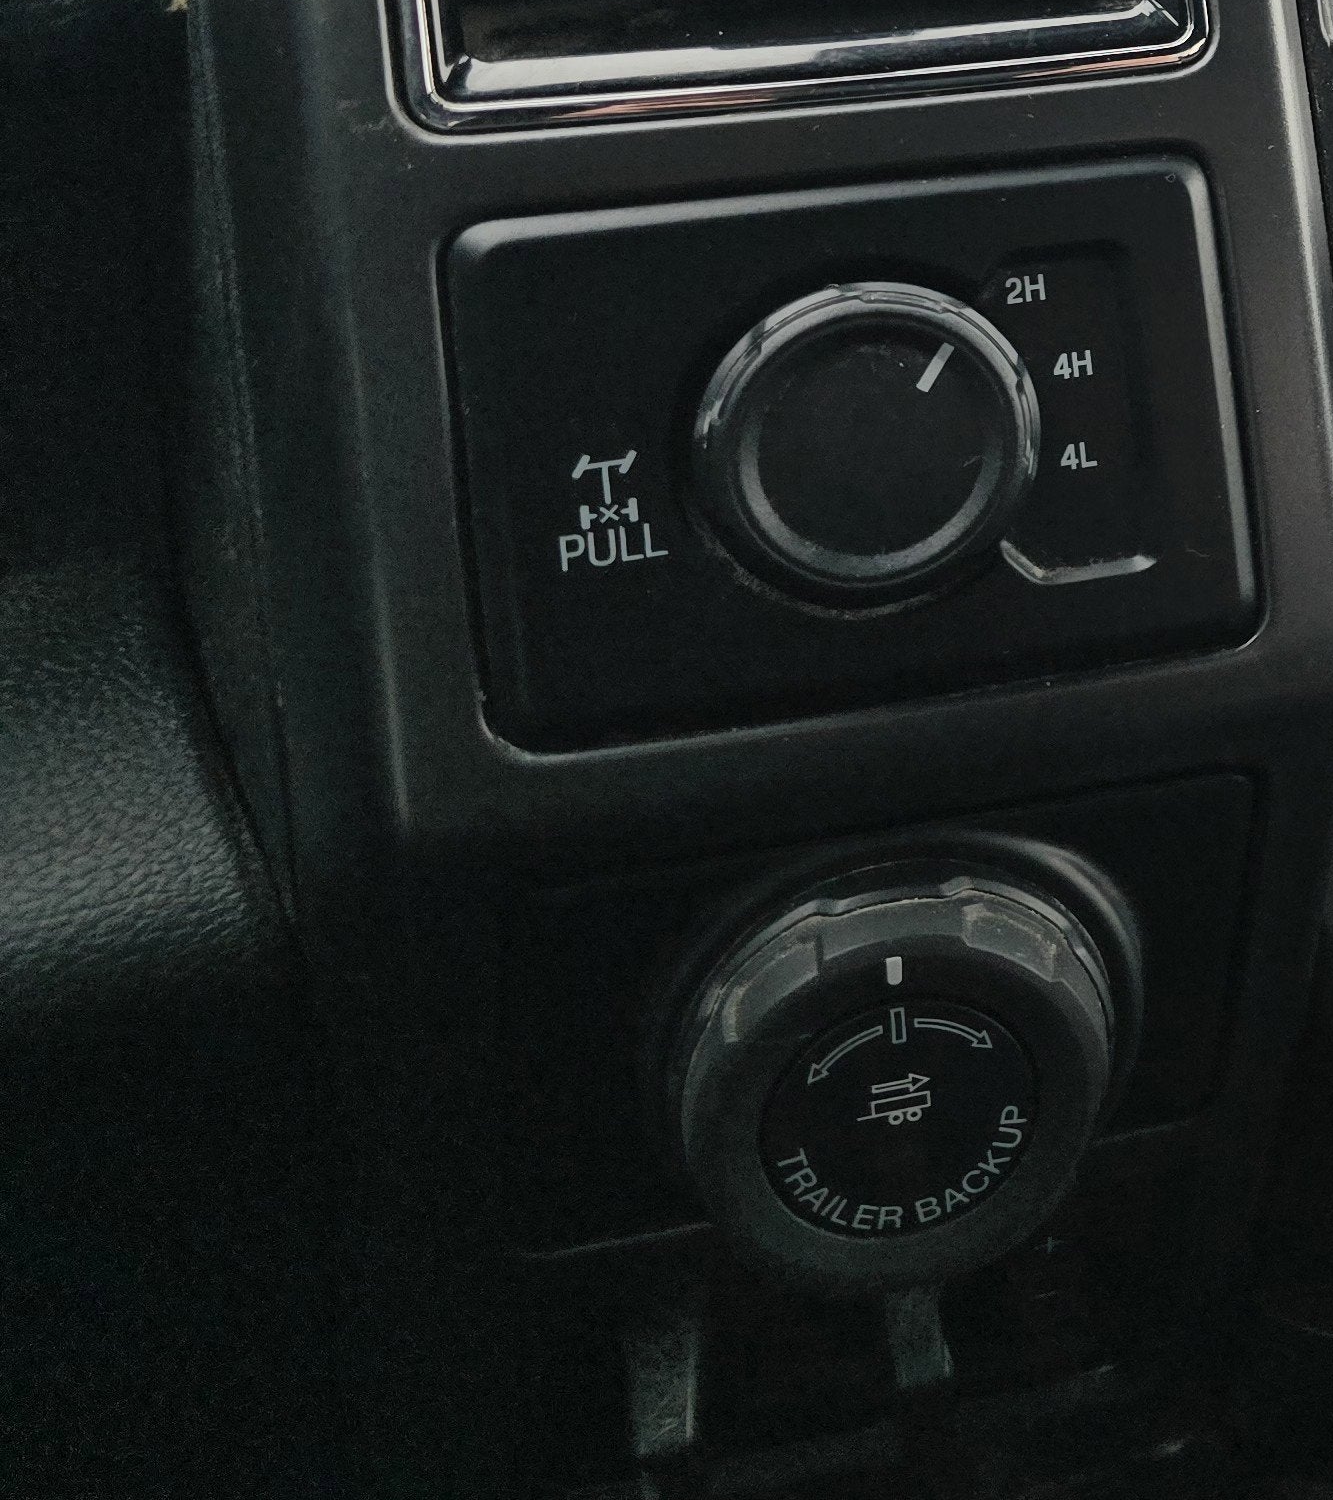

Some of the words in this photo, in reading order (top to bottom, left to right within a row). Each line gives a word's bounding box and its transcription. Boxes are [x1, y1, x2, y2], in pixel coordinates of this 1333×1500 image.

[1005, 274, 1047, 304] 2H
[1053, 351, 1093, 380] 4H
[1060, 442, 1098, 470] 4L
[558, 522, 669, 572] PULL
[777, 1148, 903, 1230] TRAILER
[915, 1105, 1028, 1224] BACKUP
